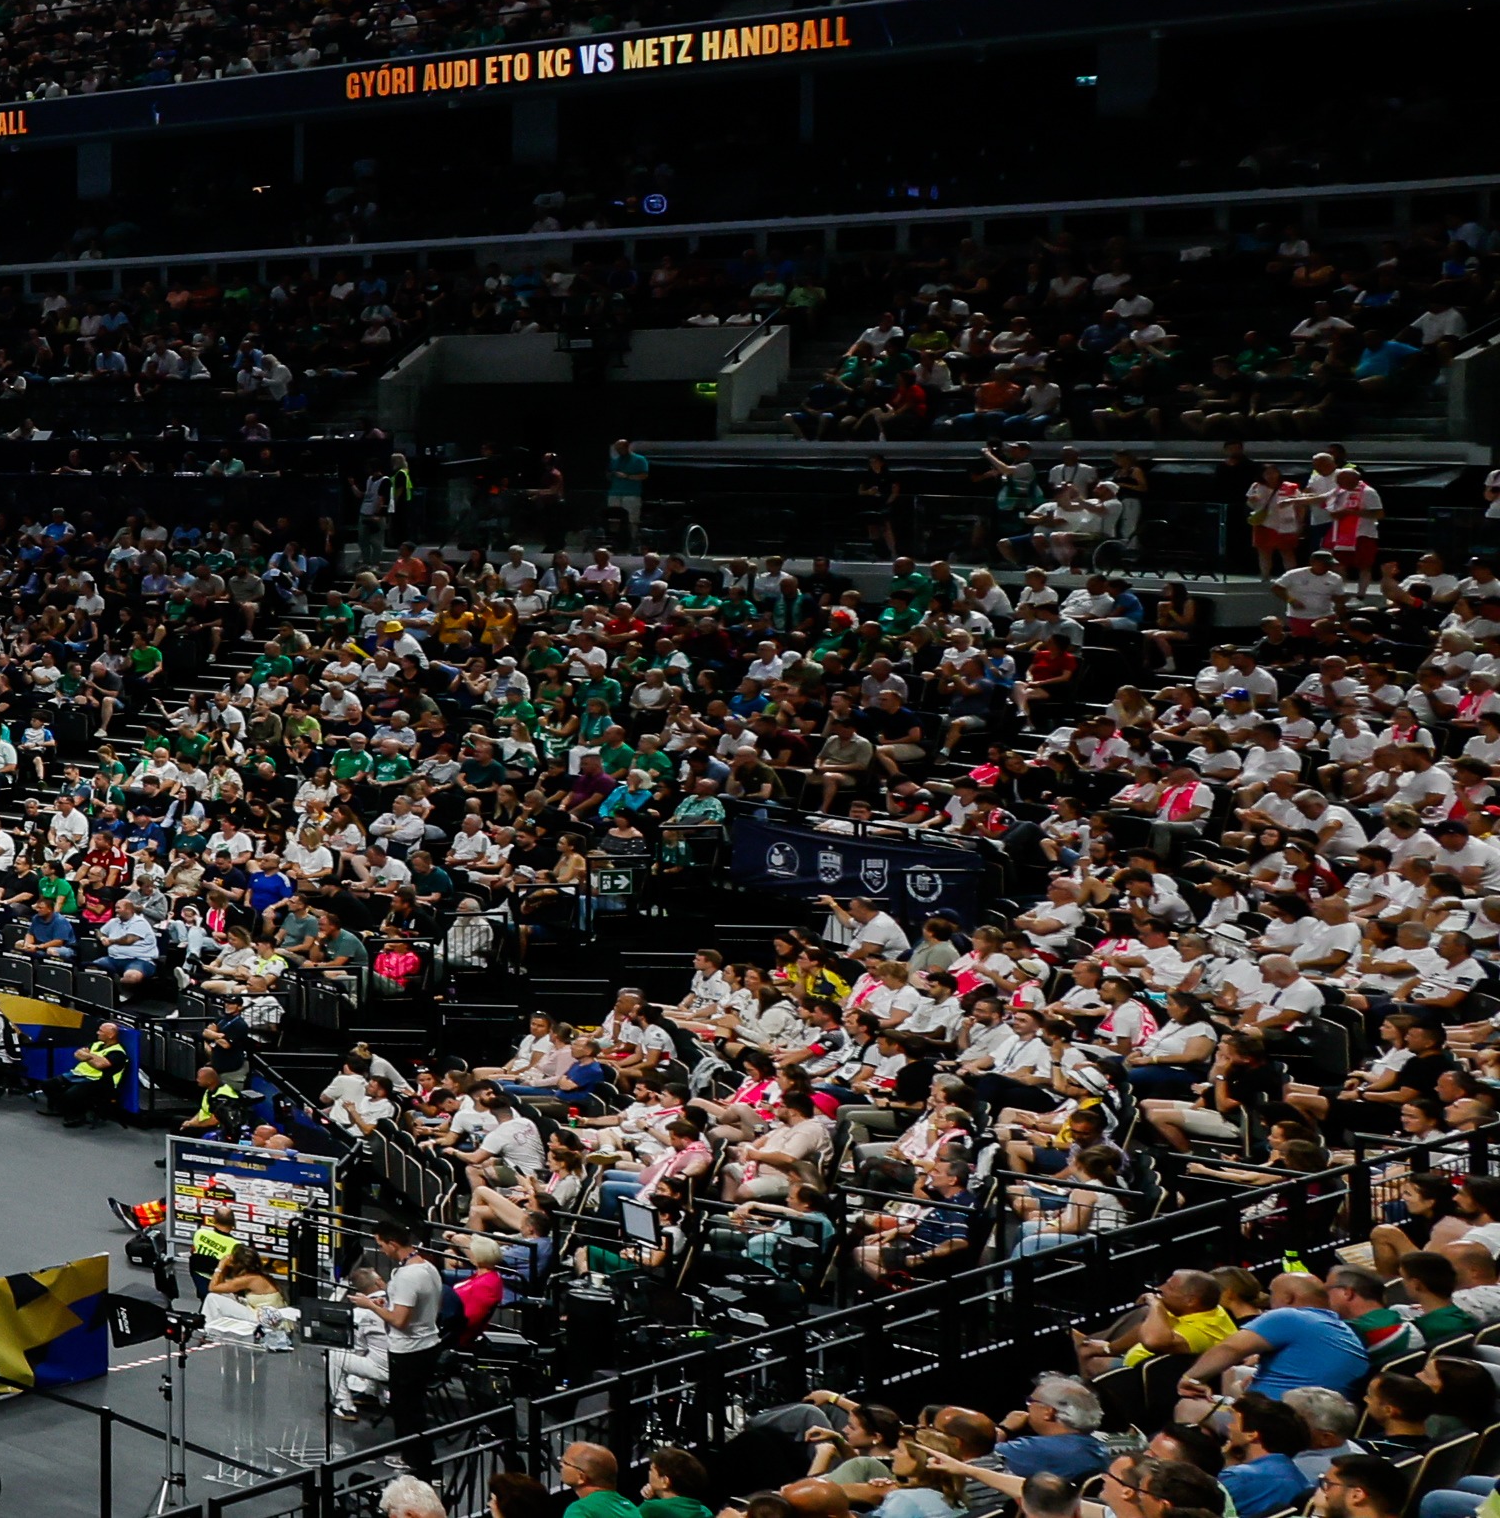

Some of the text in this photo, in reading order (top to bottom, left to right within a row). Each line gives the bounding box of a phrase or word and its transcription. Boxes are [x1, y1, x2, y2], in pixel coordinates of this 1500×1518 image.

[423, 59, 478, 91] AUDI
[486, 53, 530, 84] ETO
[538, 48, 571, 78] KC
[579, 43, 614, 74] VS
[623, 34, 693, 69] METZ
[702, 17, 850, 61] HANDBALL
